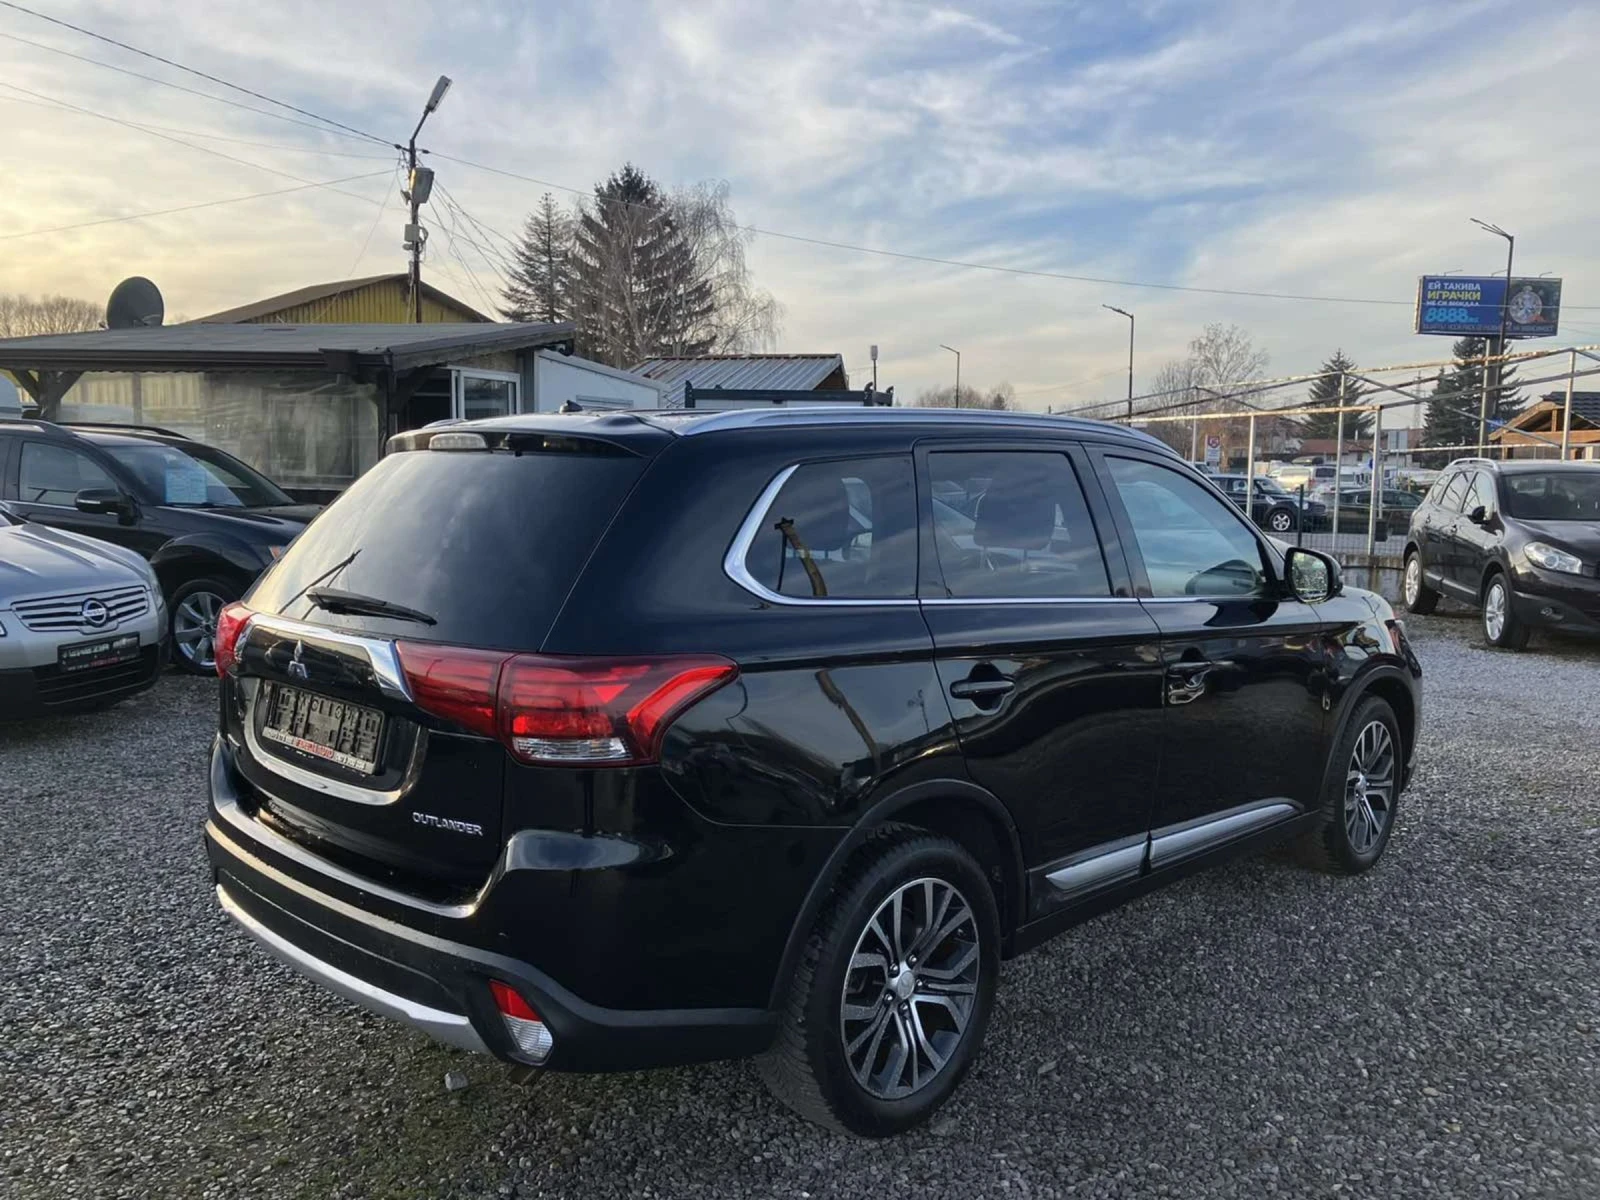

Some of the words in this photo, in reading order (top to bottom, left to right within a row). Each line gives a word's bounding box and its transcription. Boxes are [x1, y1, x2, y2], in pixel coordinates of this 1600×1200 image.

[1443, 282, 1481, 290] ТАКИВА
[1427, 290, 1481, 301] ИГРАЧКИ
[412, 811, 483, 837] OUTLANDER
